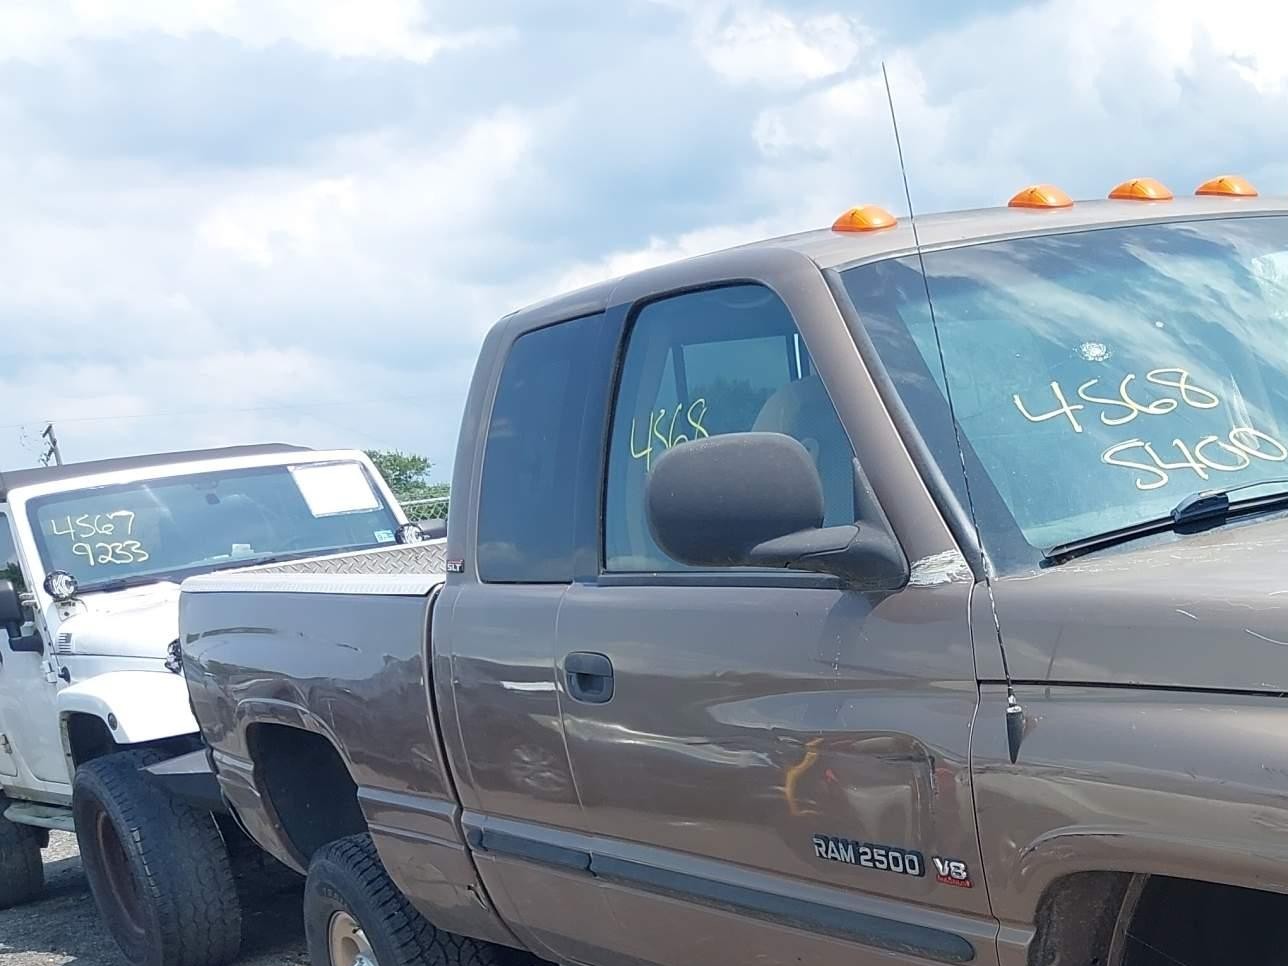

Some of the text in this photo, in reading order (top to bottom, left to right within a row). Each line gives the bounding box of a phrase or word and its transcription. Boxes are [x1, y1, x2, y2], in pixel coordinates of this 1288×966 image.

[1013, 368, 1220, 433] 4568
[51, 510, 136, 540] 4567
[72, 539, 150, 566] 9233
[812, 836, 921, 876] RAM 2500
[932, 857, 968, 880] V8
